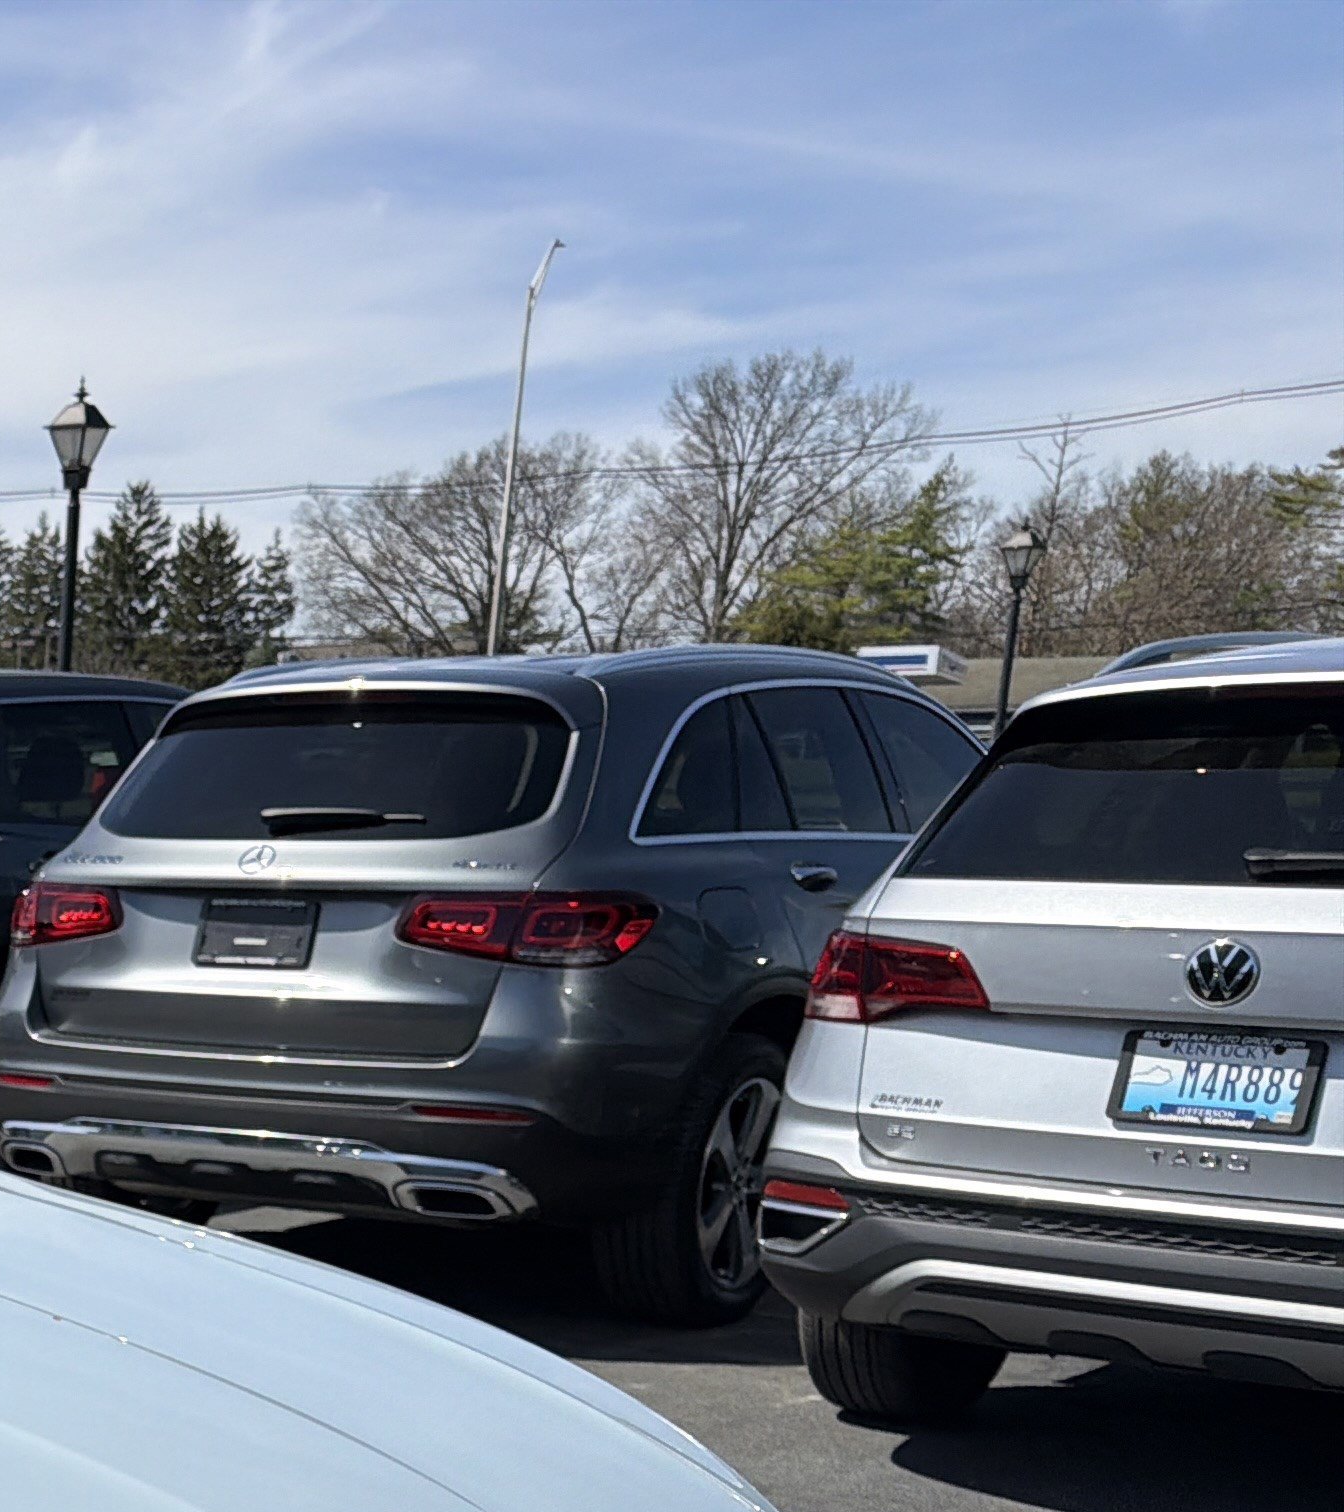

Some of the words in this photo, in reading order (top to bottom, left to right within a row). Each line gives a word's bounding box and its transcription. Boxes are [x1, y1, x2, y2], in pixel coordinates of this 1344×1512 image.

[1173, 1041, 1271, 1060] KENTUCKY
[1178, 1060, 1305, 1105] M4R889
[1176, 1106, 1237, 1119] JEFFERSON
[1145, 1147, 1250, 1171] TAOS
